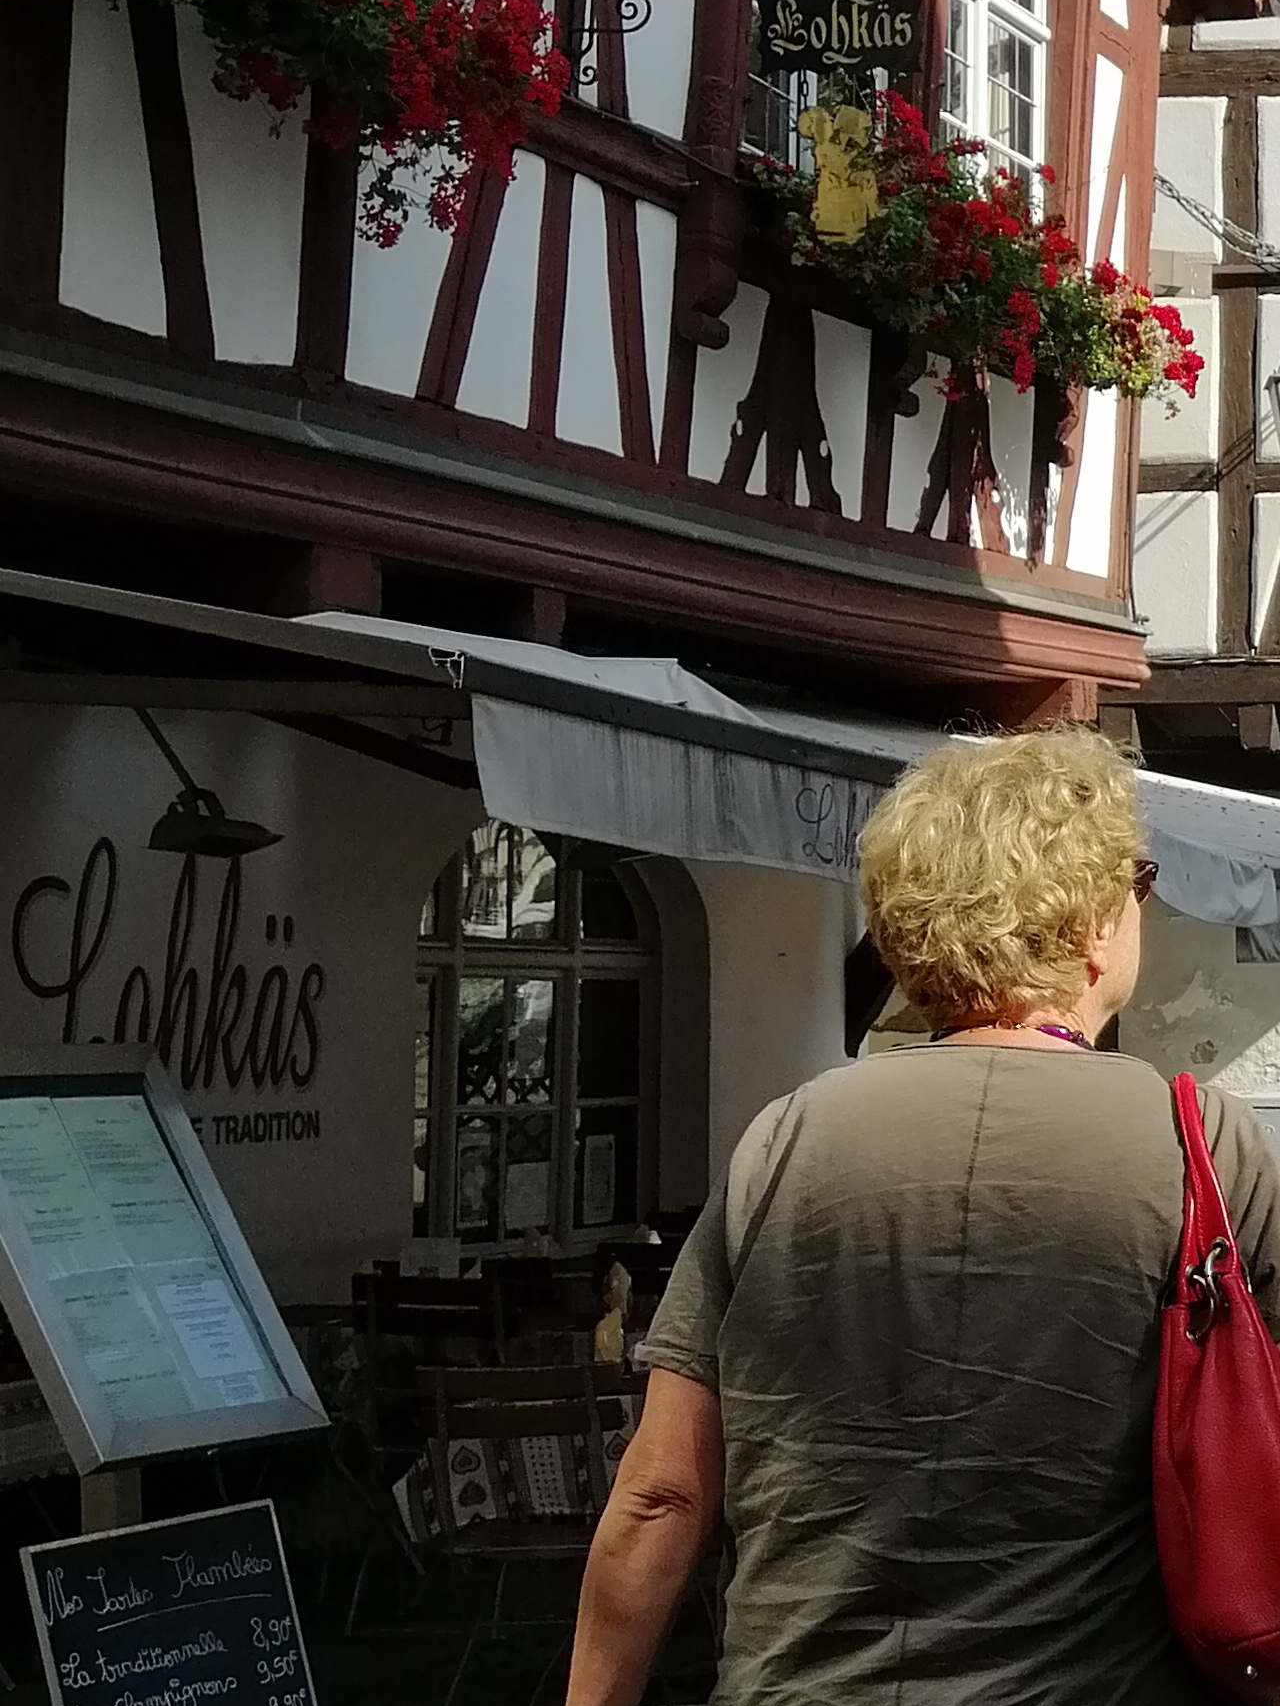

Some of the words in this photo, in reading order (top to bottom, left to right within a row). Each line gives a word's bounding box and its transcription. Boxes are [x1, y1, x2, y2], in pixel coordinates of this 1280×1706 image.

[12, 836, 327, 1092] Lohkäs
[212, 1110, 320, 1145] TRADITION
[45, 1567, 84, 1626] Nos
[86, 1567, 154, 1614] Tartes
[60, 1653, 95, 1688] La
[96, 1630, 229, 1683] traditionnelle
